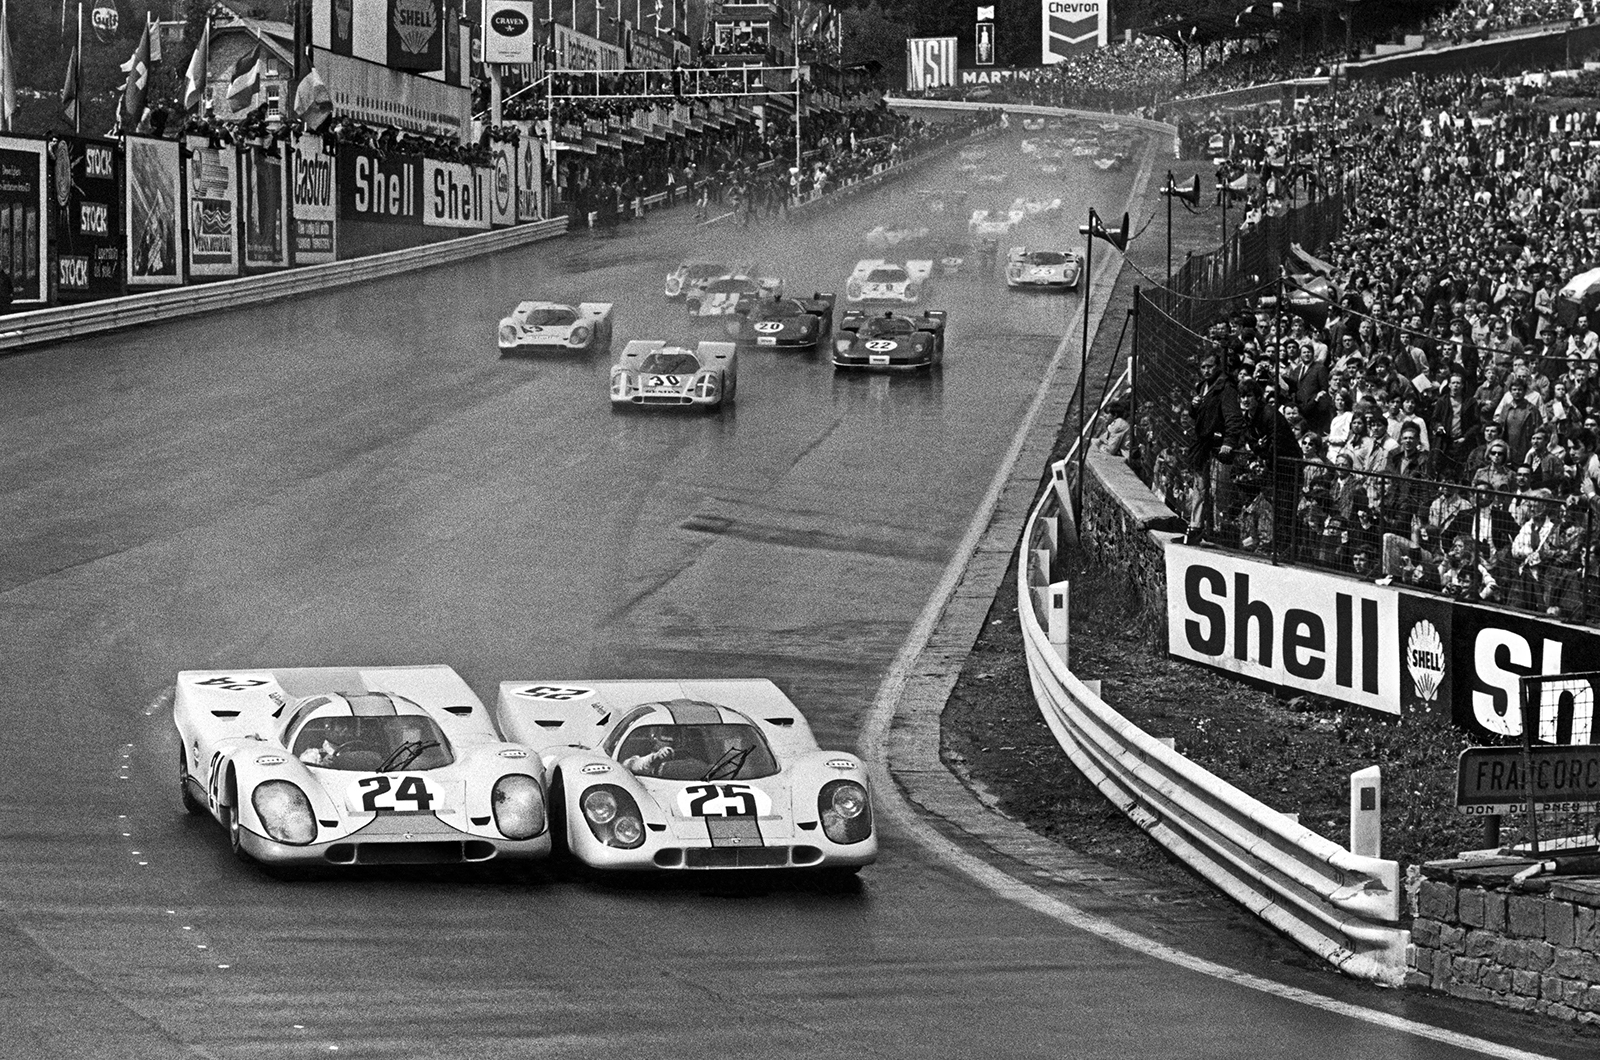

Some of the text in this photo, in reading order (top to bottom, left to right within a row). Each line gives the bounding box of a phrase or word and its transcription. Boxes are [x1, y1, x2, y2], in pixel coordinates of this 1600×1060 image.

[400, 9, 431, 27] SHELL
[495, 17, 525, 25] CRAVEN
[1048, 2, 1099, 13] Chevron
[86, 148, 112, 175] STOCK
[295, 148, 331, 206] Castrol
[355, 155, 414, 216] Shell
[433, 167, 483, 221] Shell
[81, 205, 107, 232] STOCK
[60, 259, 87, 286] STOCK
[869, 341, 891, 349] 22
[649, 375, 680, 386] 30
[1184, 564, 1379, 695] Shell
[1412, 649, 1441, 672] SHELL
[358, 776, 434, 812] 24
[686, 784, 758, 817] 25
[1466, 803, 1580, 815] DON DU PNEU
